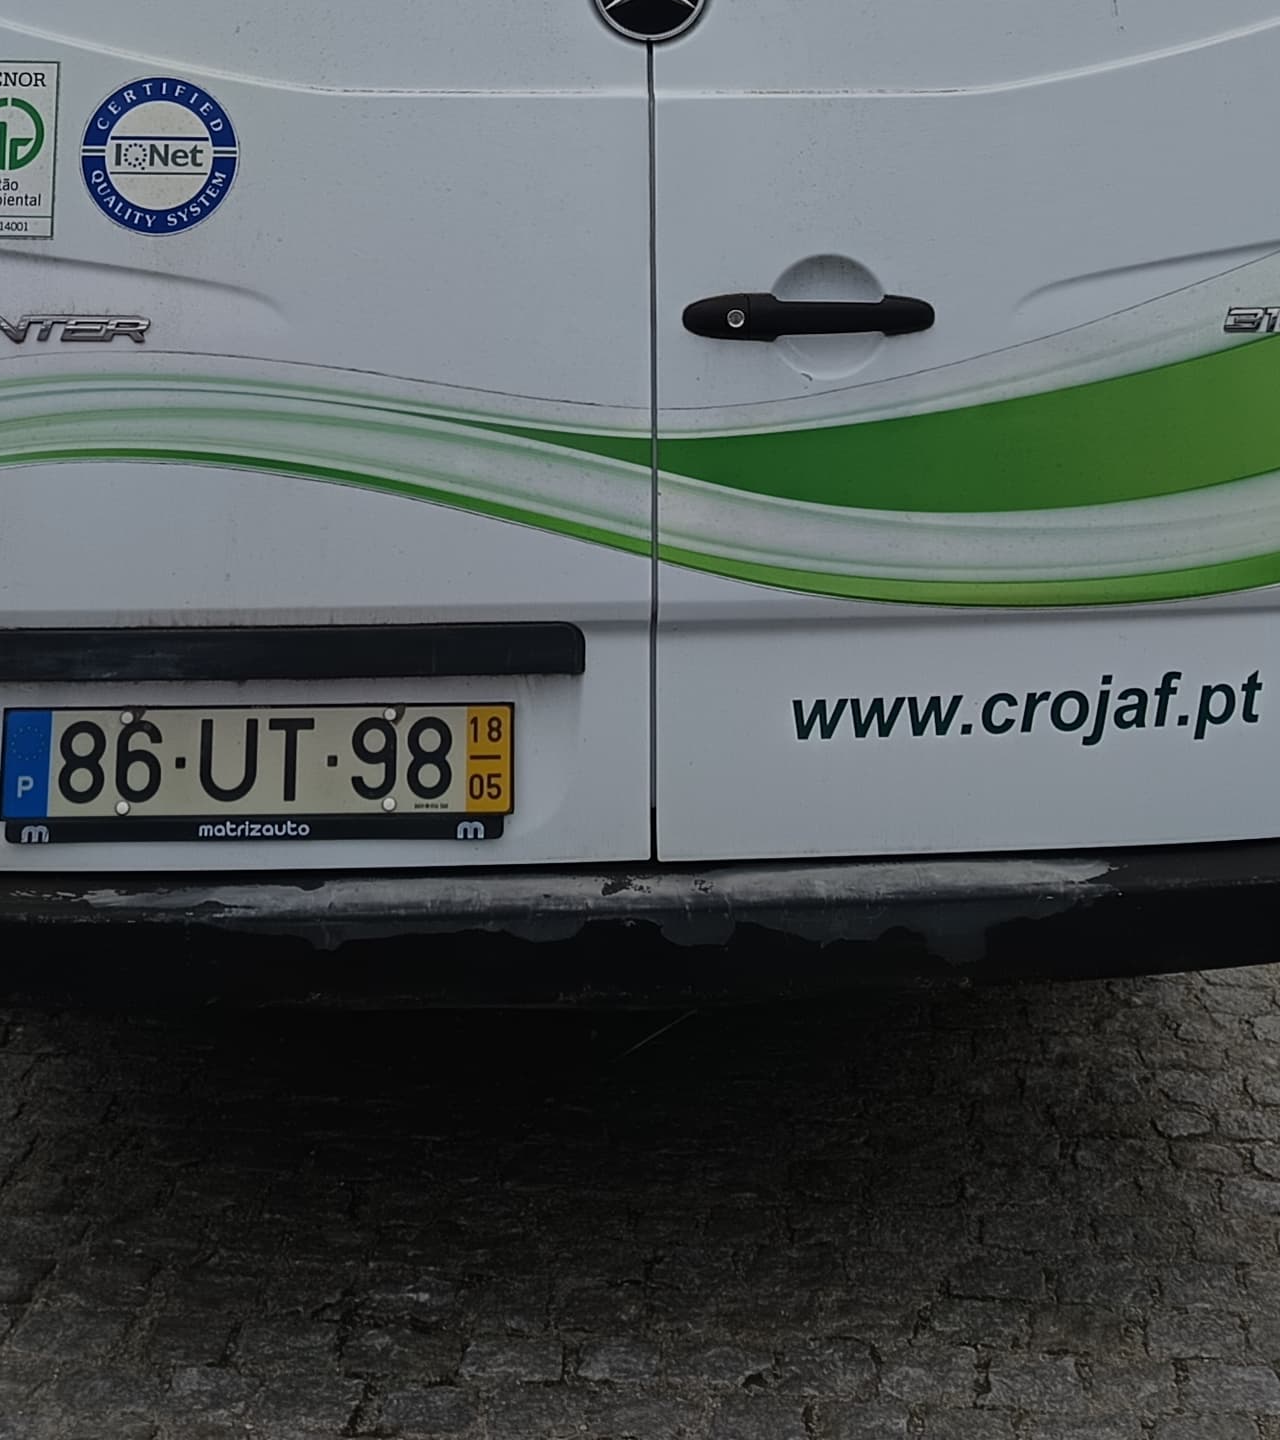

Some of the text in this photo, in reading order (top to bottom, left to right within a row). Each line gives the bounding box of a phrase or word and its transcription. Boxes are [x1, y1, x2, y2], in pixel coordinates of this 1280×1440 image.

[96, 82, 224, 132] CERTIFIED
[114, 142, 204, 171] IQNet
[91, 169, 227, 228] QUALITY SYSTEM
[0, 221, 29, 232] 14001
[791, 669, 1263, 747] www.crojaf.pt
[470, 716, 502, 743] 18
[16, 776, 35, 799] P
[469, 772, 502, 800] 05
[198, 820, 311, 838] matrizauto
